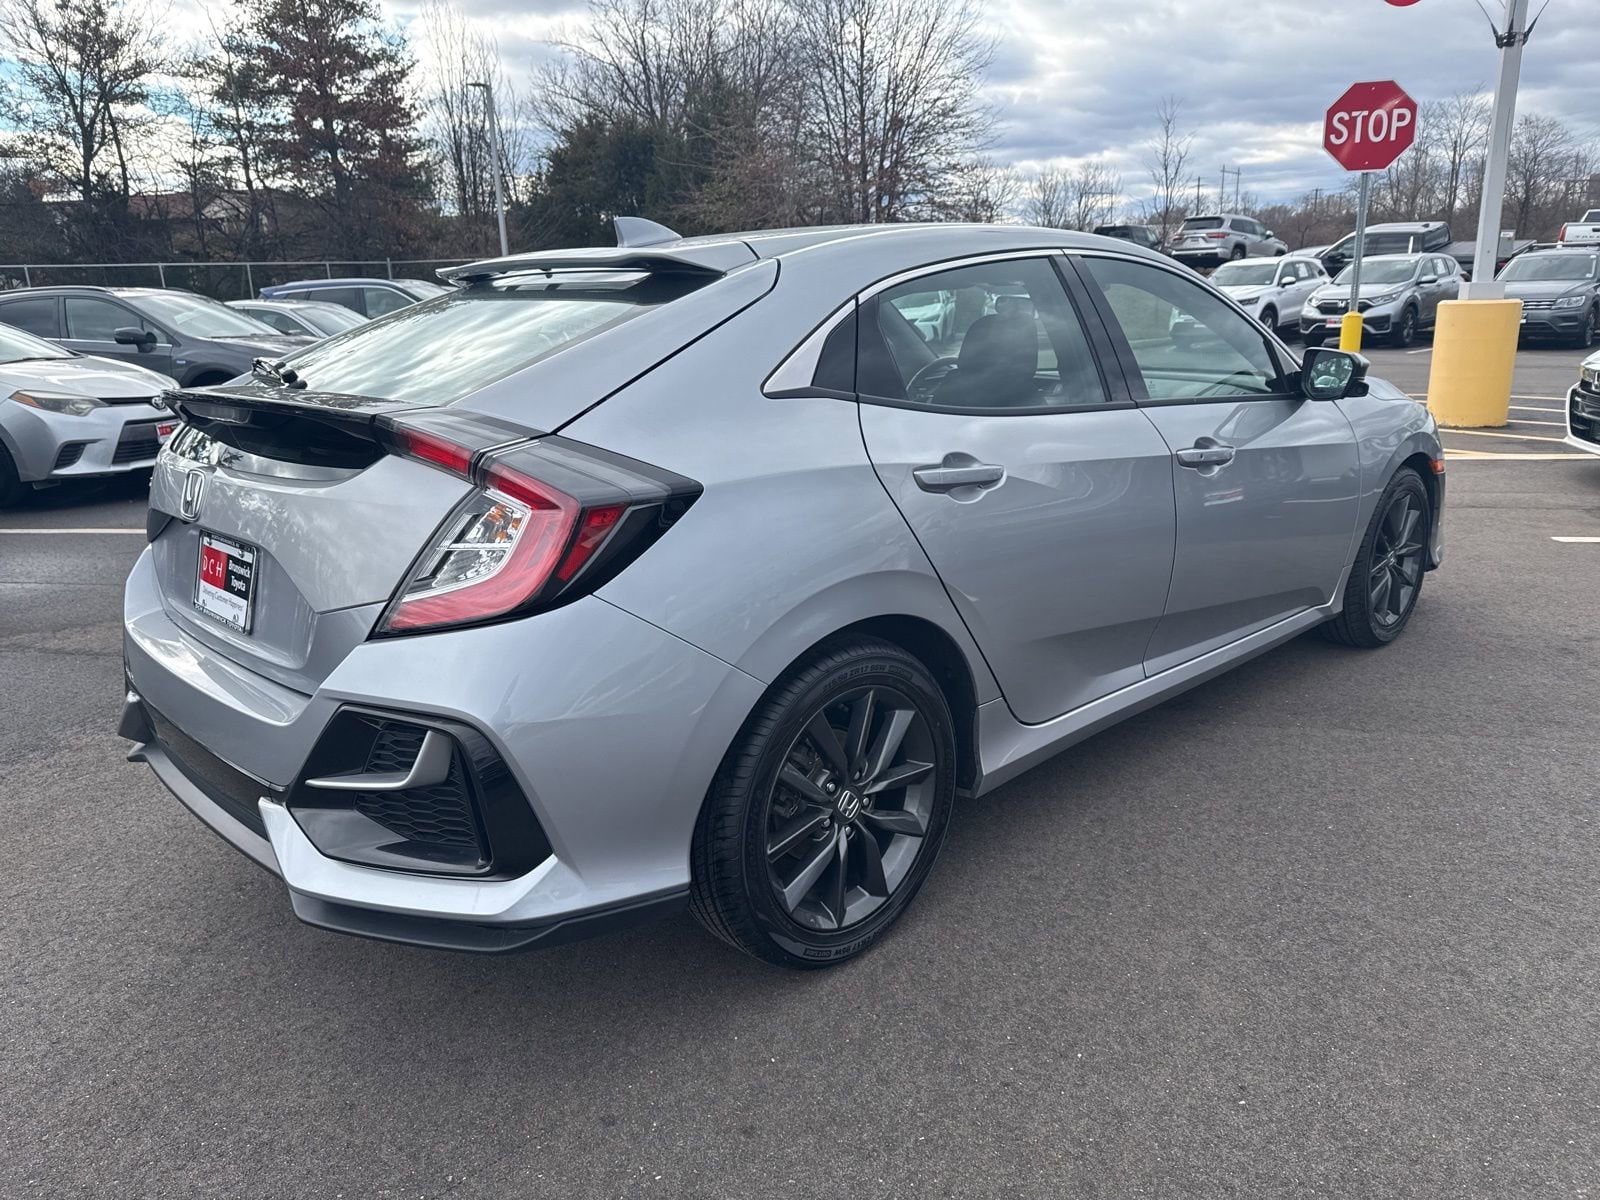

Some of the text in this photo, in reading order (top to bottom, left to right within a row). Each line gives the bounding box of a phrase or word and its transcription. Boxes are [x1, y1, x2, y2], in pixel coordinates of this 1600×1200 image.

[1329, 108, 1411, 145] STOP
[202, 555, 223, 578] DCH
[228, 559, 251, 578] Brunswick
[231, 576, 246, 592] Toyota
